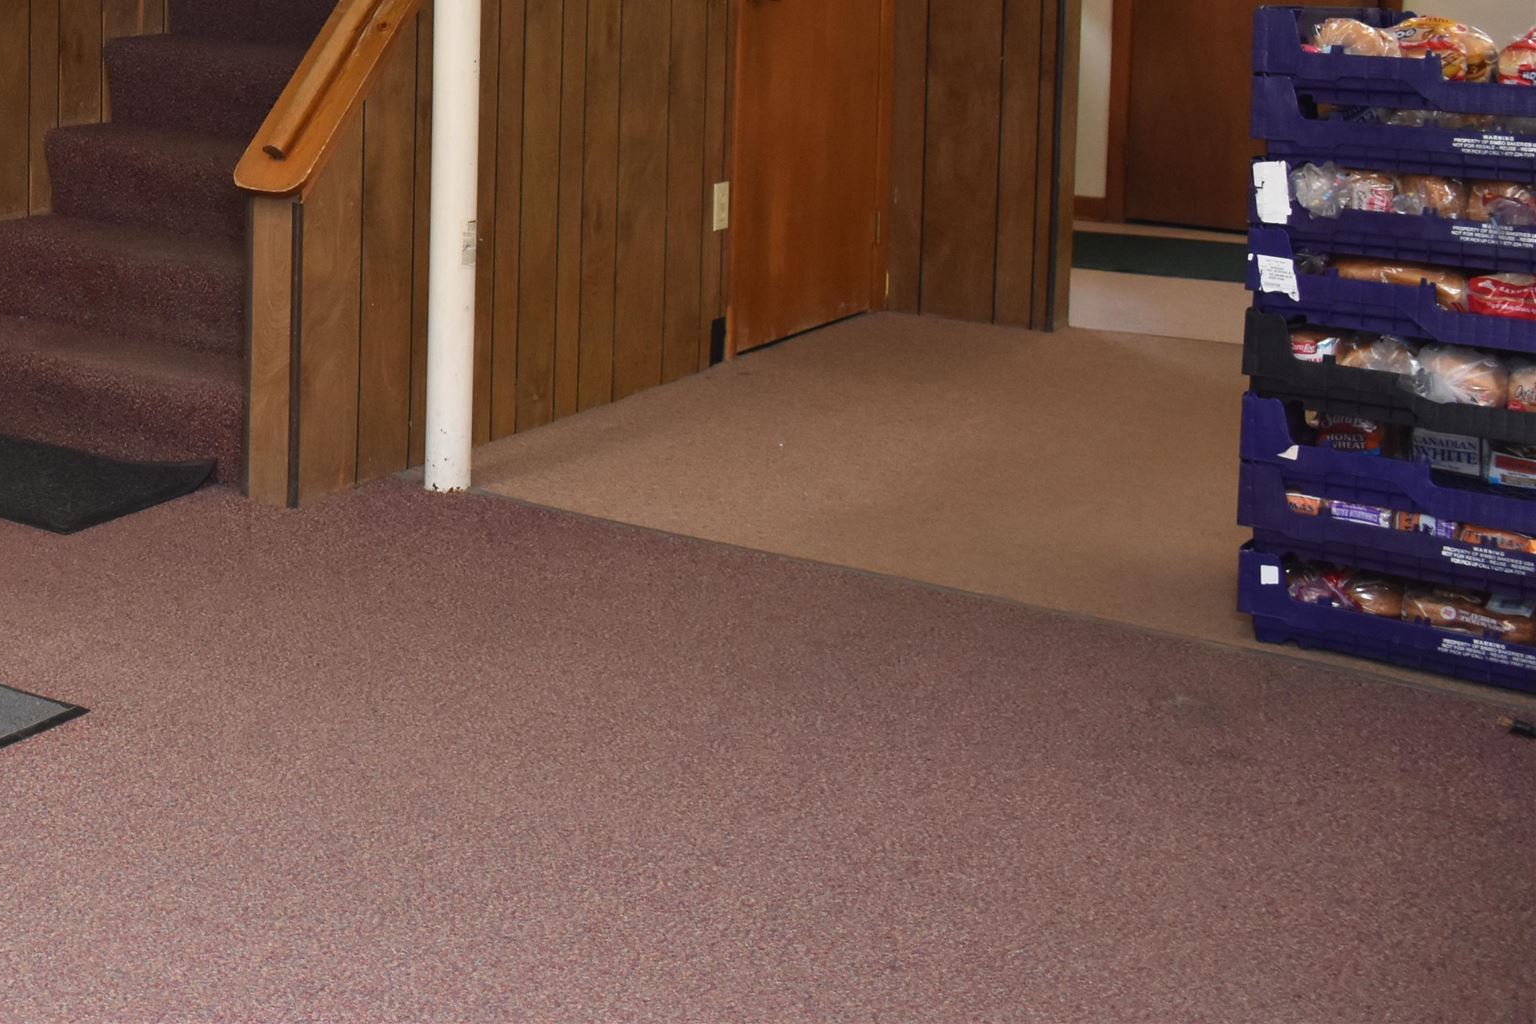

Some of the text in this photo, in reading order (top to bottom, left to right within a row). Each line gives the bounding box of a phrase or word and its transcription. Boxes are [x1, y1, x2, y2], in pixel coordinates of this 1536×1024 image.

[1414, 436, 1478, 450] CANADIAN
[1414, 446, 1478, 464] WHITE
[1472, 546, 1504, 556] WARNING
